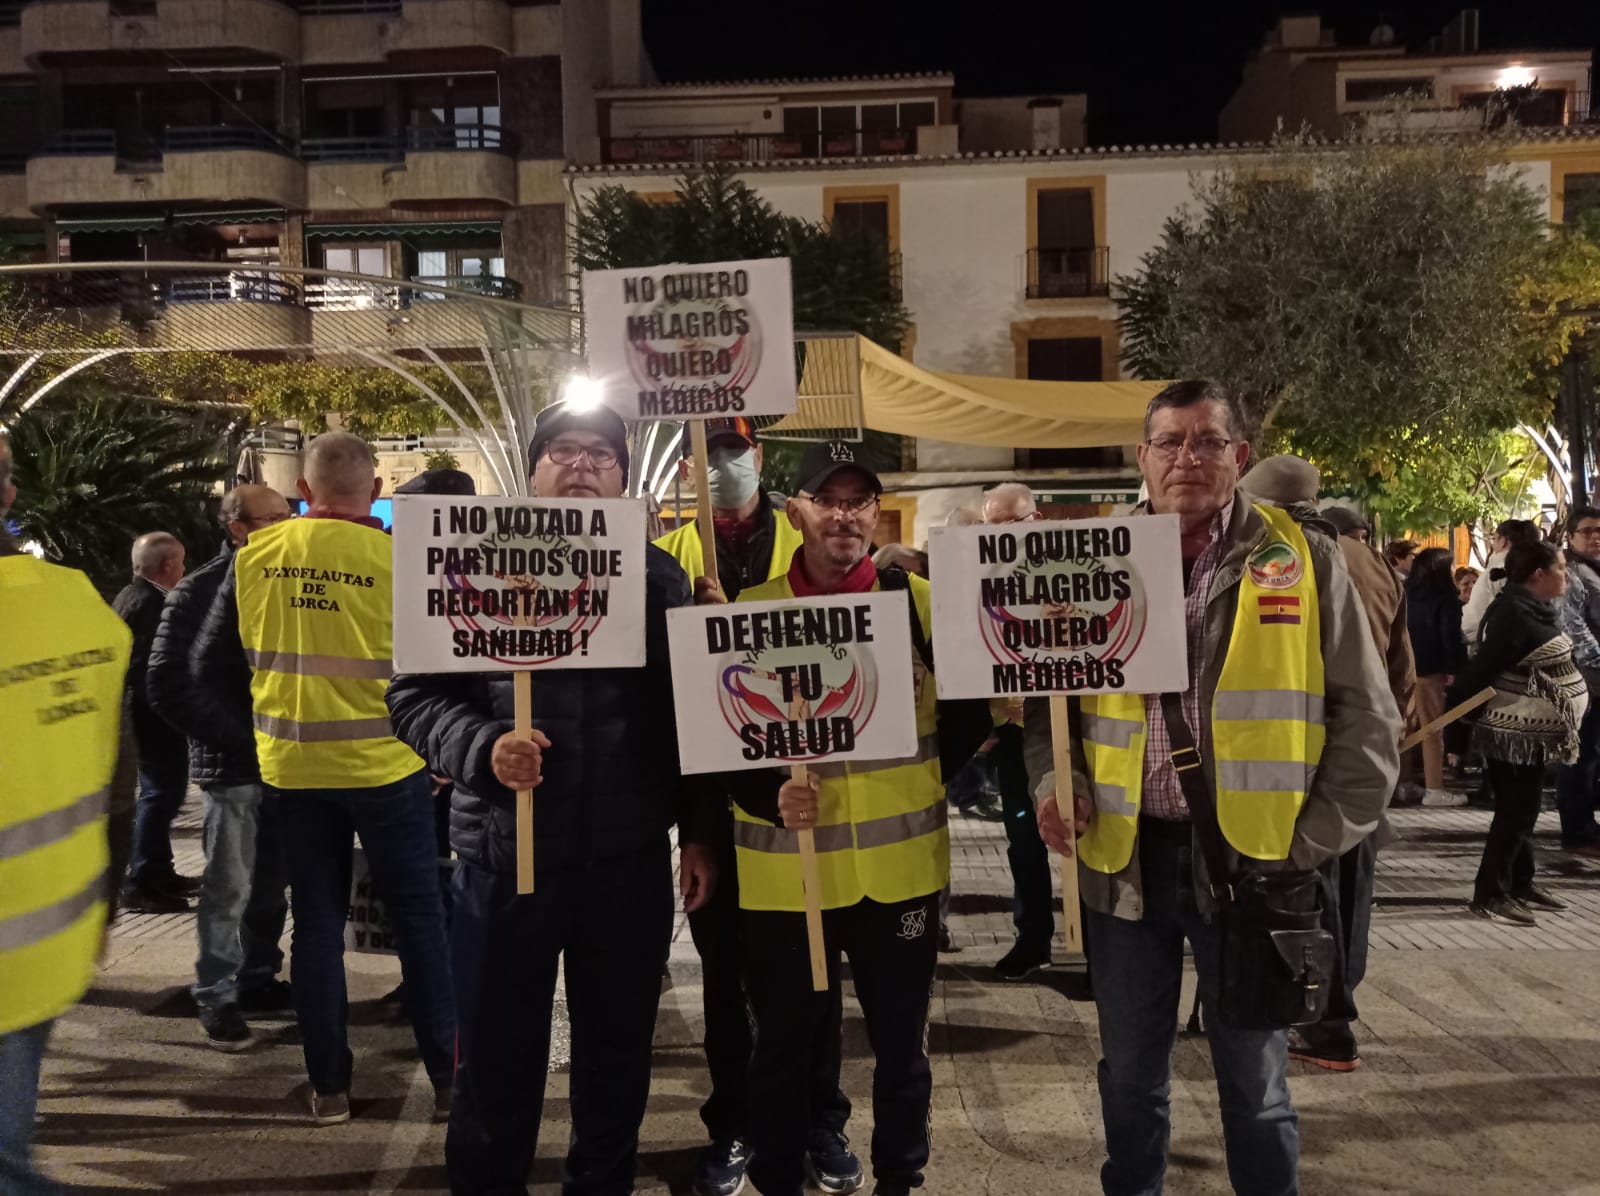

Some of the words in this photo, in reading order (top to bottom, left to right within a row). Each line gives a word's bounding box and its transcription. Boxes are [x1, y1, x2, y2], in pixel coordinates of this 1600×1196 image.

[624, 275, 655, 304] NO
[663, 269, 748, 301] QUIERO
[627, 308, 749, 342] MILAGROS
[646, 348, 732, 381] QUIERO
[1091, 494, 1127, 503] BAR
[450, 505, 487, 535] NO
[495, 506, 583, 536] VOTAD
[590, 509, 607, 537] A
[978, 533, 1017, 564] NO
[1024, 526, 1131, 562] QUIERO
[262, 566, 375, 588] YAYOFLAUTAS
[427, 547, 564, 577] PARTIDOS
[571, 549, 622, 579] QUE
[290, 597, 340, 612] LORCA
[302, 582, 326, 595] DE
[427, 589, 569, 617] RECORTAN
[578, 590, 608, 617] EN
[981, 570, 1131, 608] MILAGROS
[453, 629, 574, 657] SANIDAD
[706, 605, 874, 654] DEFIENDE
[1003, 615, 1109, 652] QUIERO
[775, 663, 823, 703] TU
[741, 716, 855, 761] SALUD
